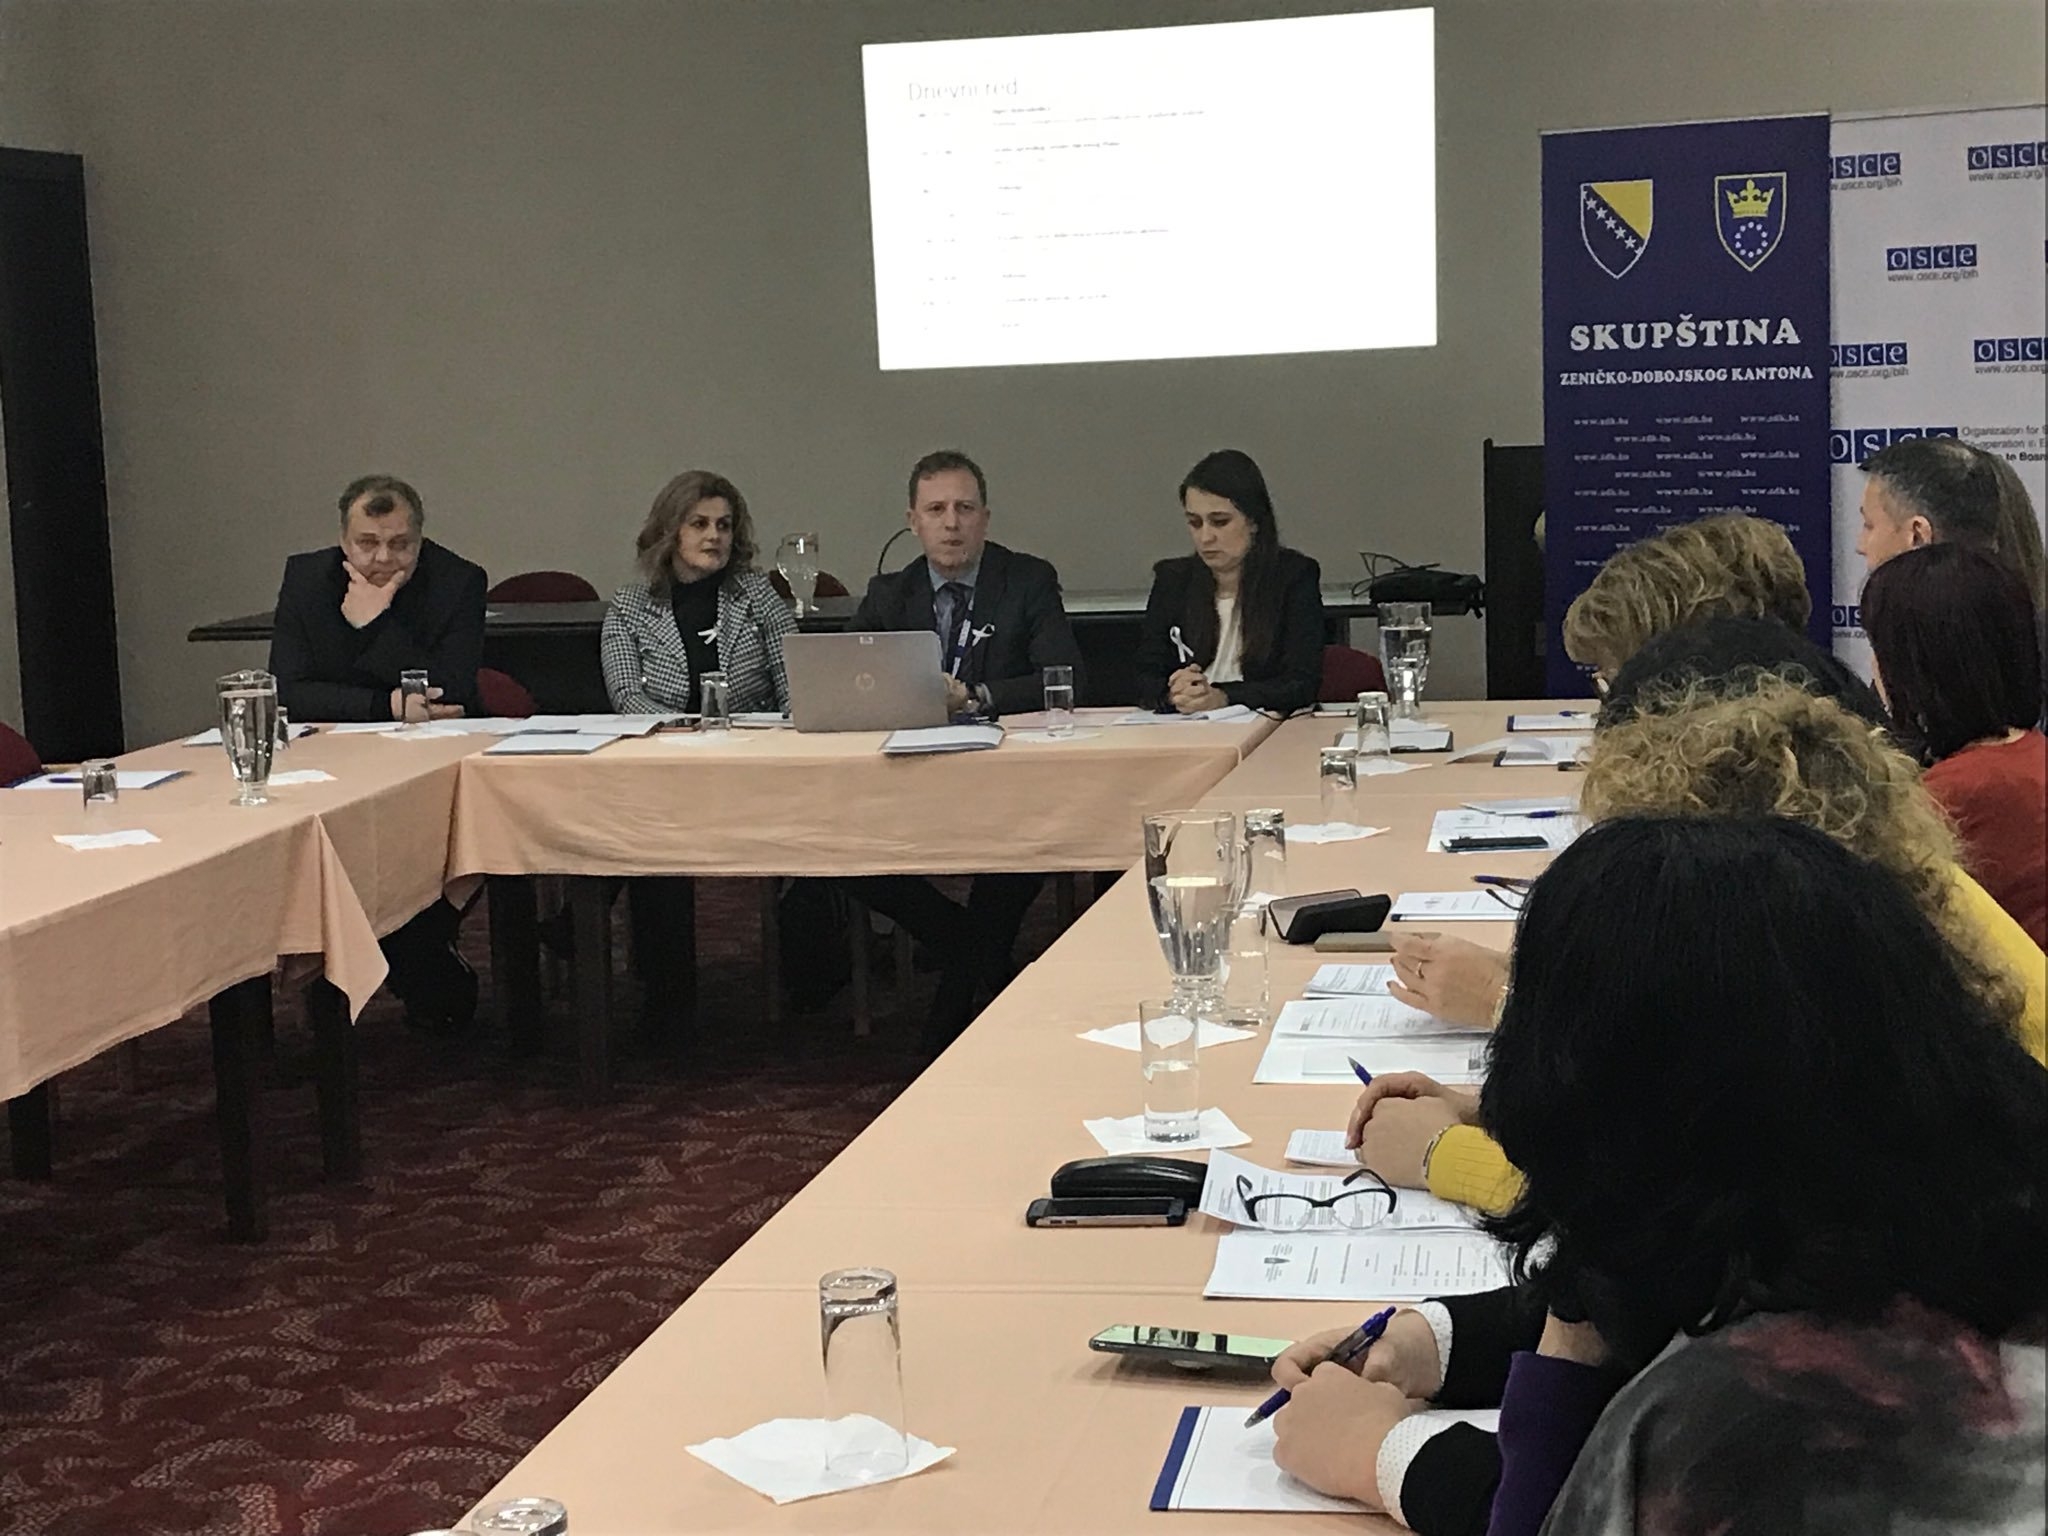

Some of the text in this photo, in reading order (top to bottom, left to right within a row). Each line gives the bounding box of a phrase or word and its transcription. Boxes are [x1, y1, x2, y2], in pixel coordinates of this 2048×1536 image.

[909, 77, 1018, 101] Dnevni red
[1832, 154, 1899, 178] sce
[1889, 245, 1976, 269] osce
[1570, 313, 1800, 351] SKUPŠTINA
[1977, 338, 2047, 363] osc
[1560, 366, 1814, 386] ZENIČKO-DOBOJSKOG KANTONA
[1962, 425, 2024, 438] Organization
[2026, 425, 2039, 434] for
[2019, 451, 2047, 461] Bosn
